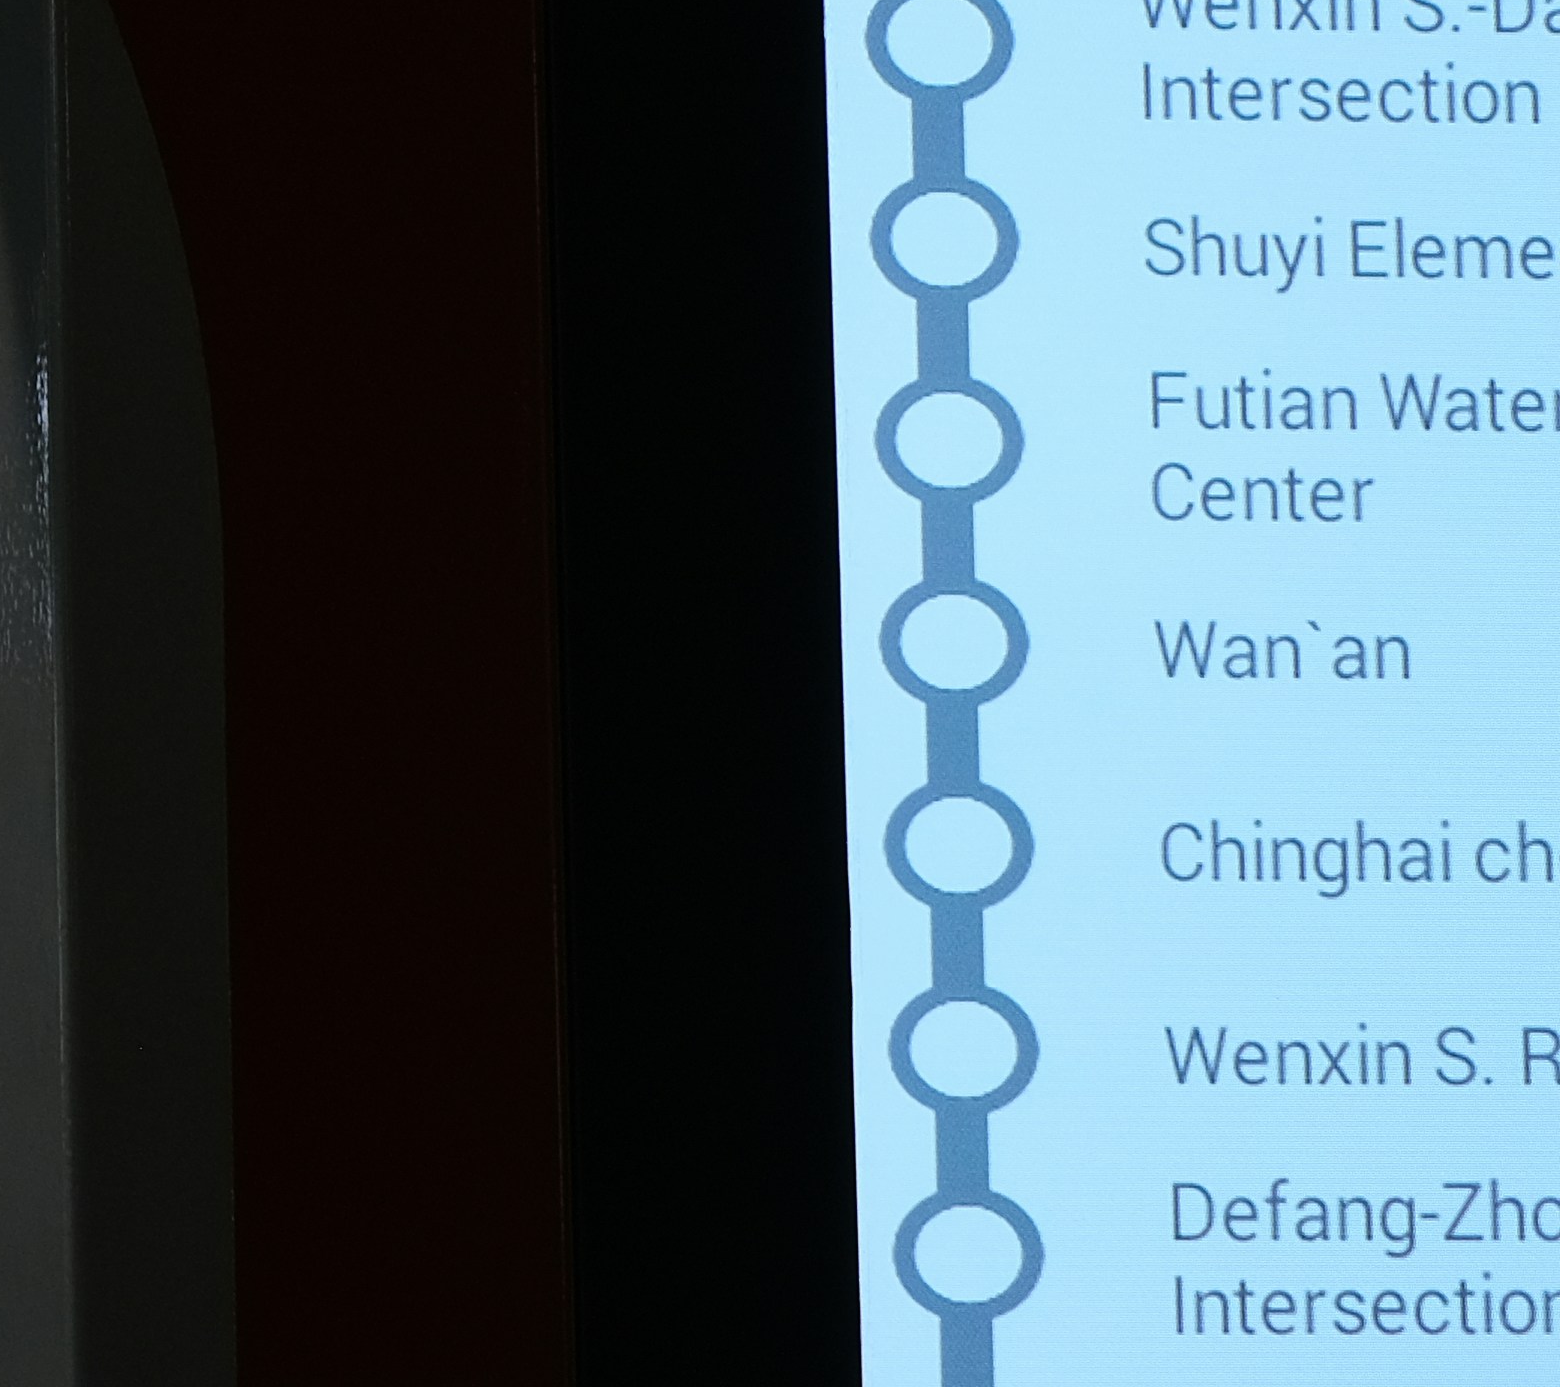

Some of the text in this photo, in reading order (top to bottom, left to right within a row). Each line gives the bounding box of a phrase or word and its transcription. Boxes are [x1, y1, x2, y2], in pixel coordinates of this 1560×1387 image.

[1142, 61, 1541, 125] Intersection
[1145, 214, 1325, 295] Shuyi
[1150, 367, 1358, 431] Futian
[1152, 461, 1374, 523] Center
[1161, 819, 1560, 900] Chinghai ch
[1164, 1022, 1412, 1086] Wenxin
[1435, 1025, 1493, 1087] S.
